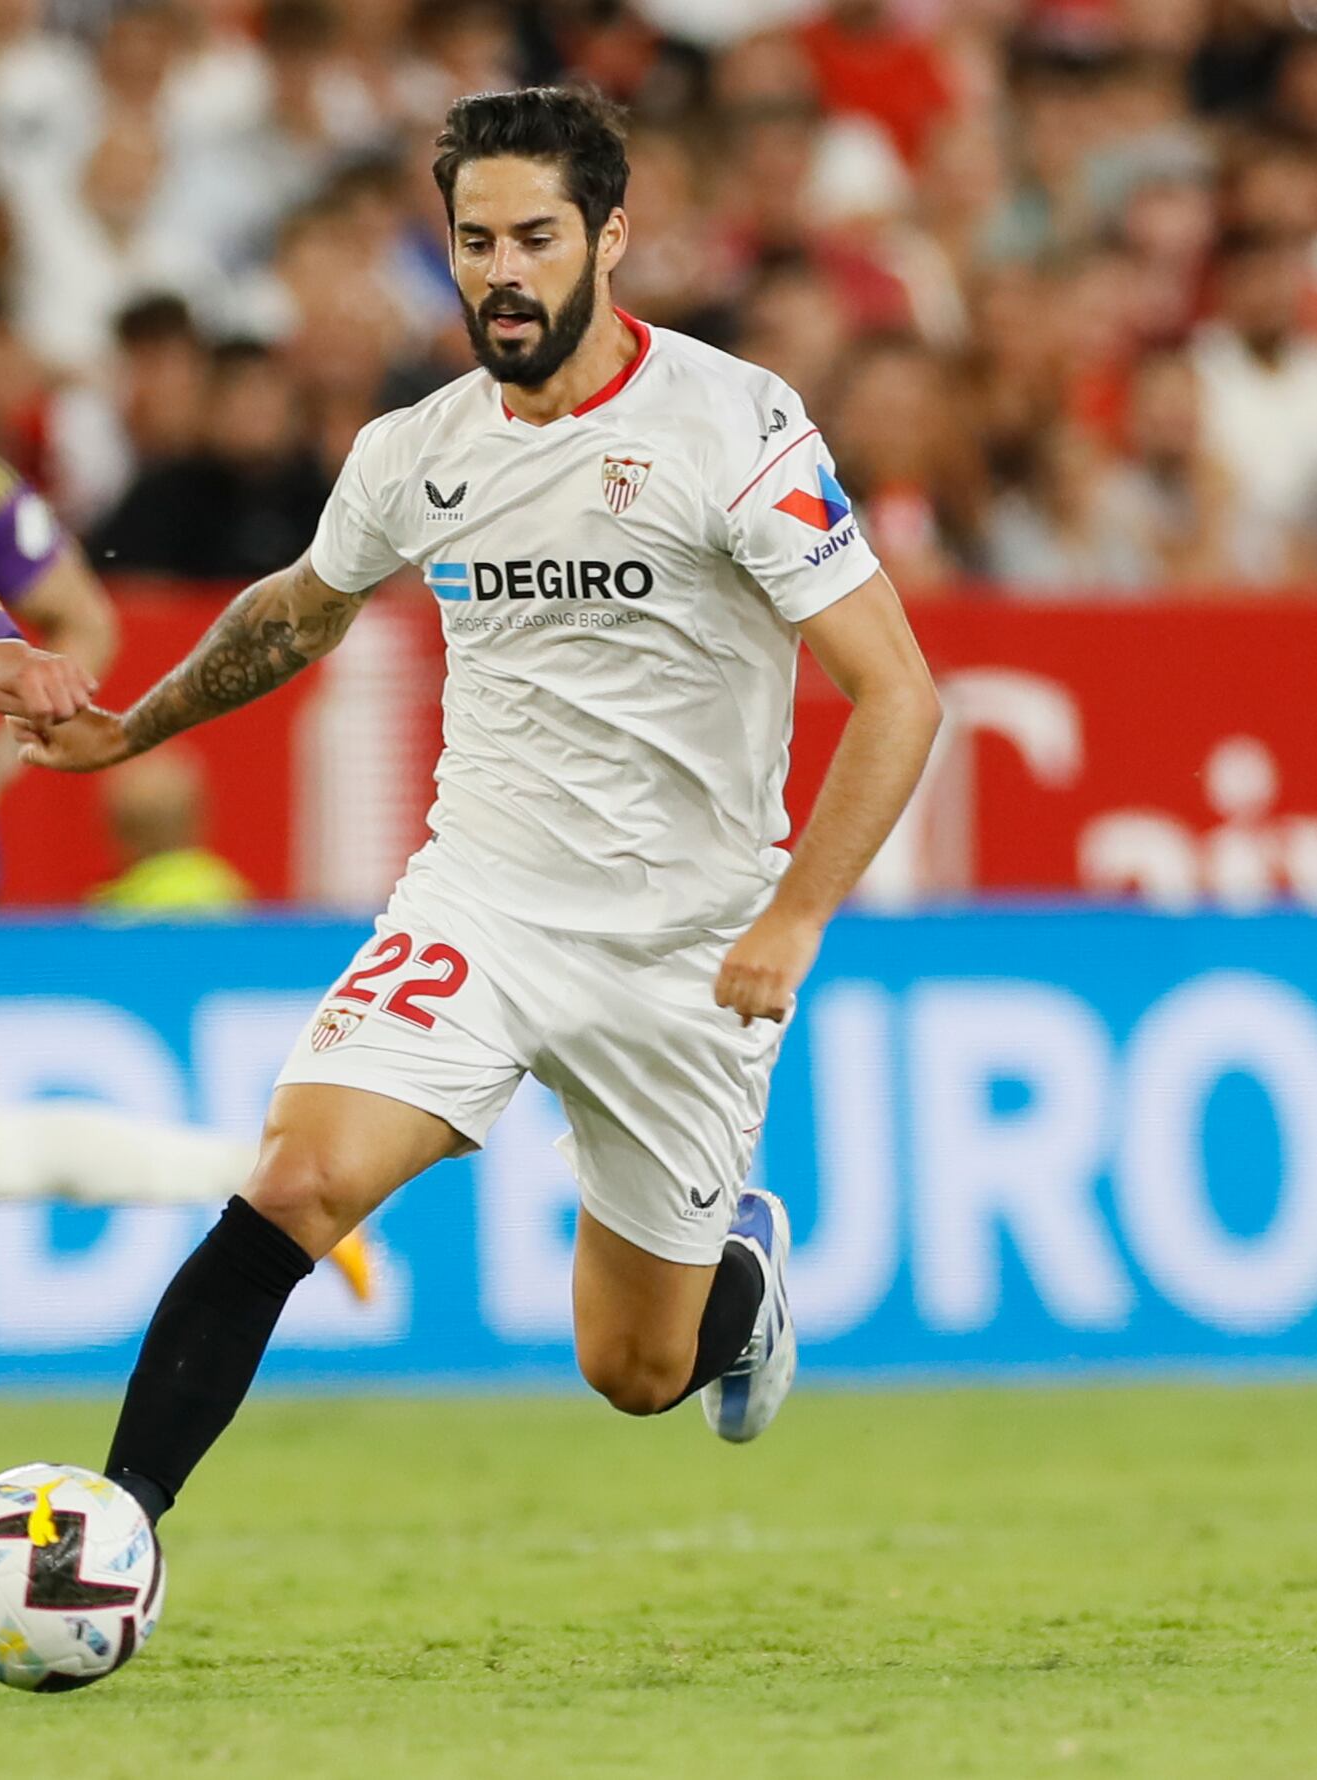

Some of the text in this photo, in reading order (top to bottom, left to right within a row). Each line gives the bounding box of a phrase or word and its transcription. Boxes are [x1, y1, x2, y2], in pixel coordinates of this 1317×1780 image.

[474, 560, 653, 601] DEGIRO
[507, 612, 575, 629] LEADING
[331, 932, 469, 1031] 22
